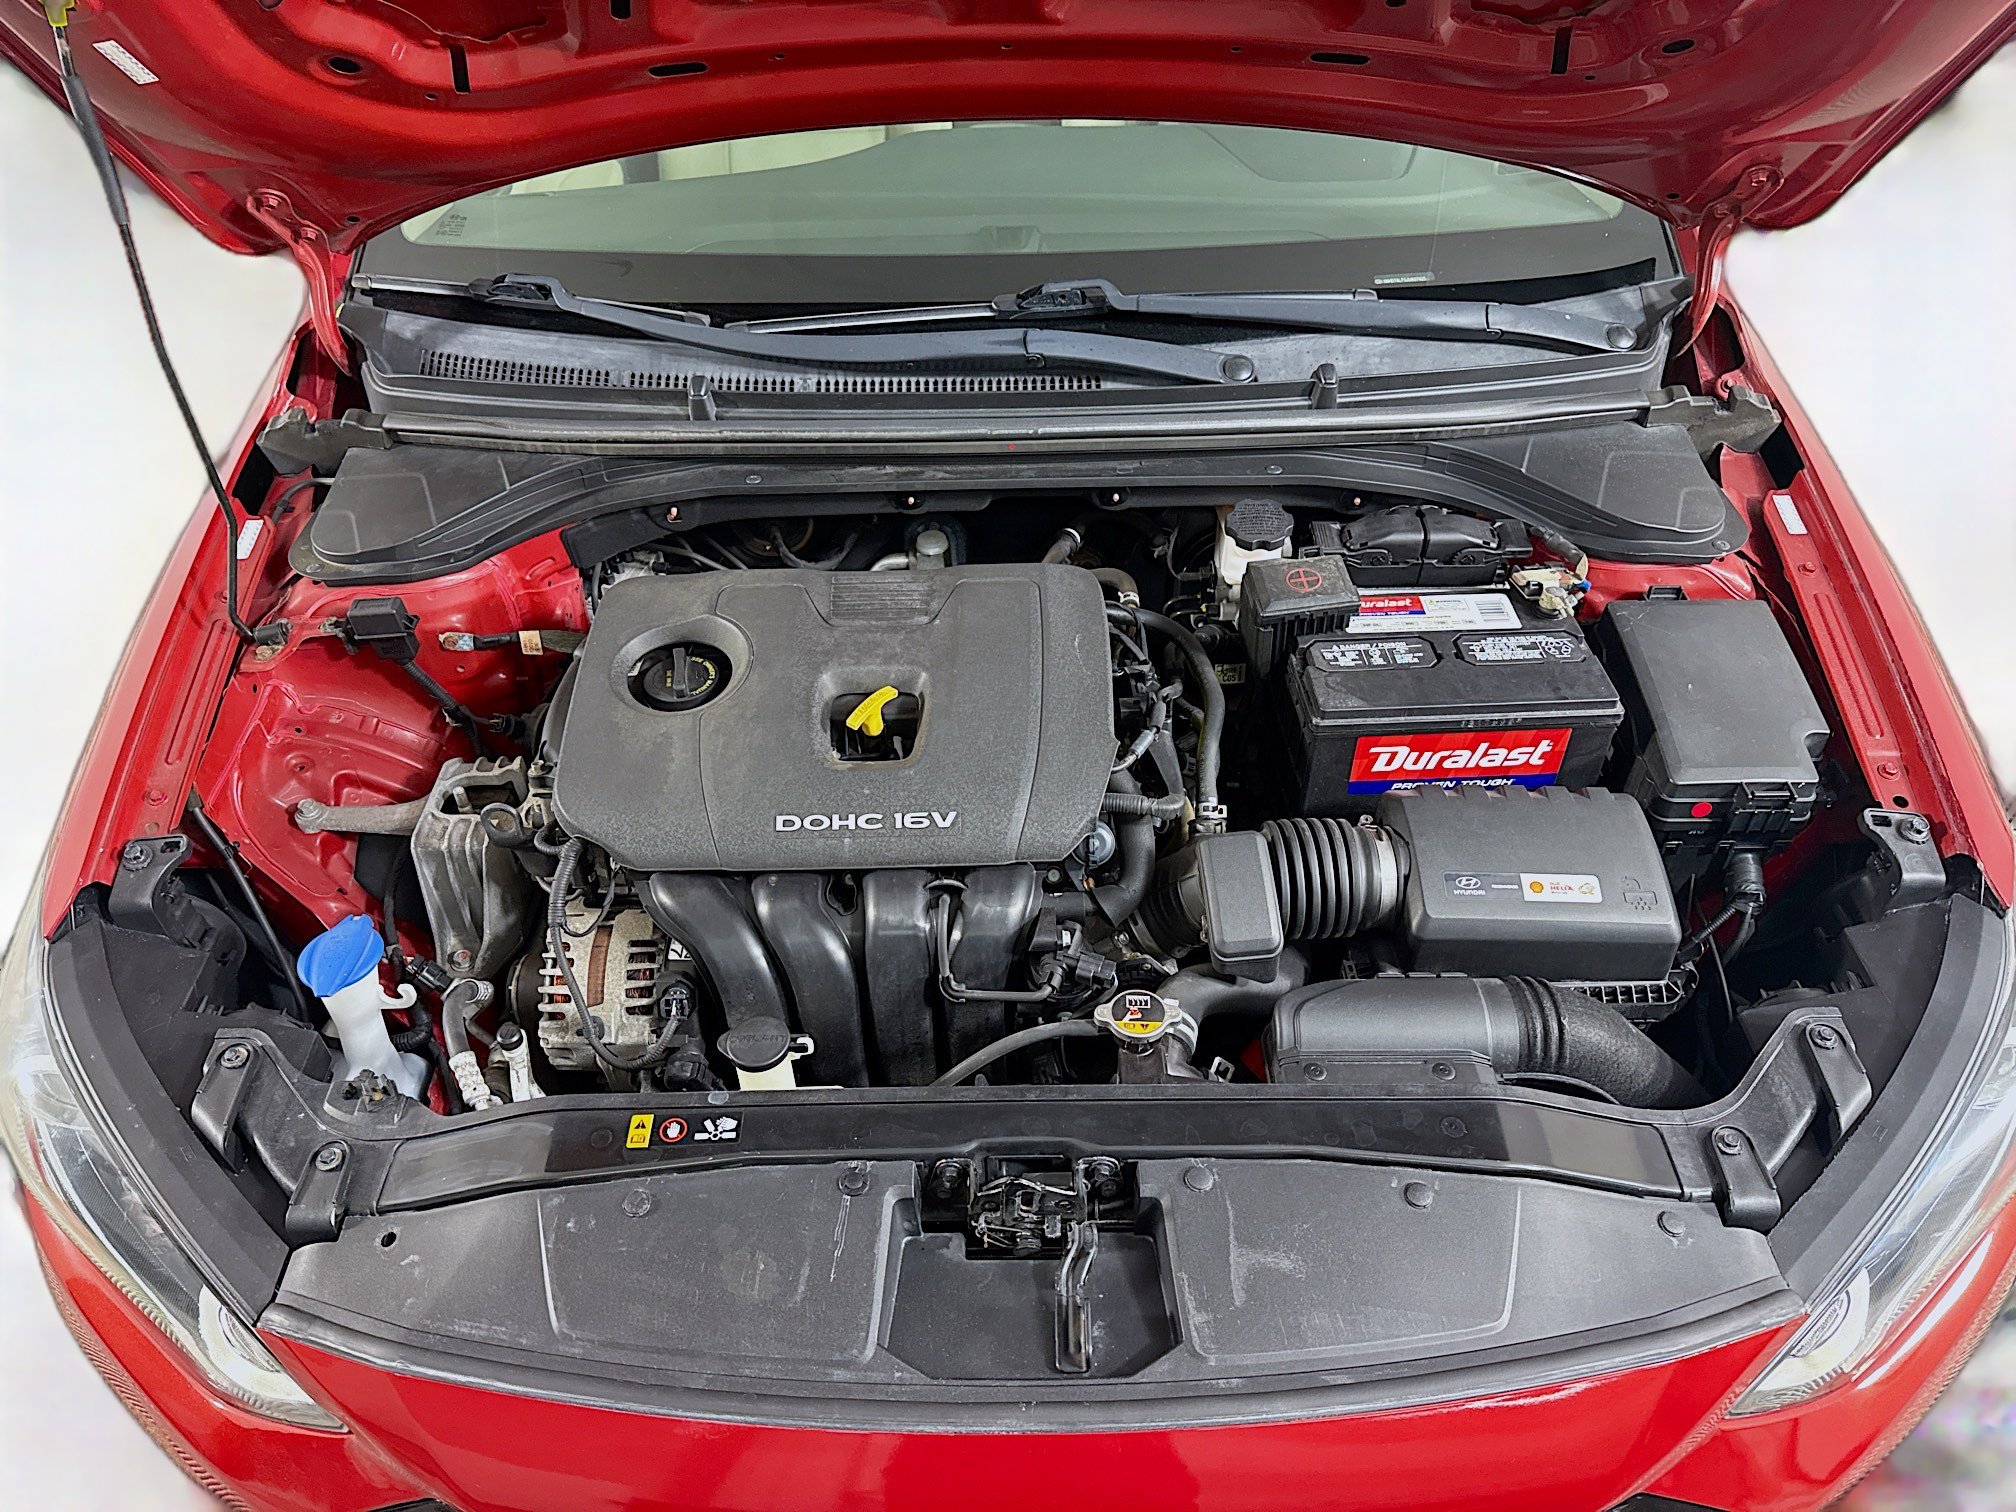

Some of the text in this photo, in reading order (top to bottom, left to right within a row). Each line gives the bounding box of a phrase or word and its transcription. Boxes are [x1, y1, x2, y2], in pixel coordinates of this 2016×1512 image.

[1360, 598, 1412, 608] uralast
[1369, 739, 1553, 772] Duralast
[775, 811, 958, 832] DOHC 16V
